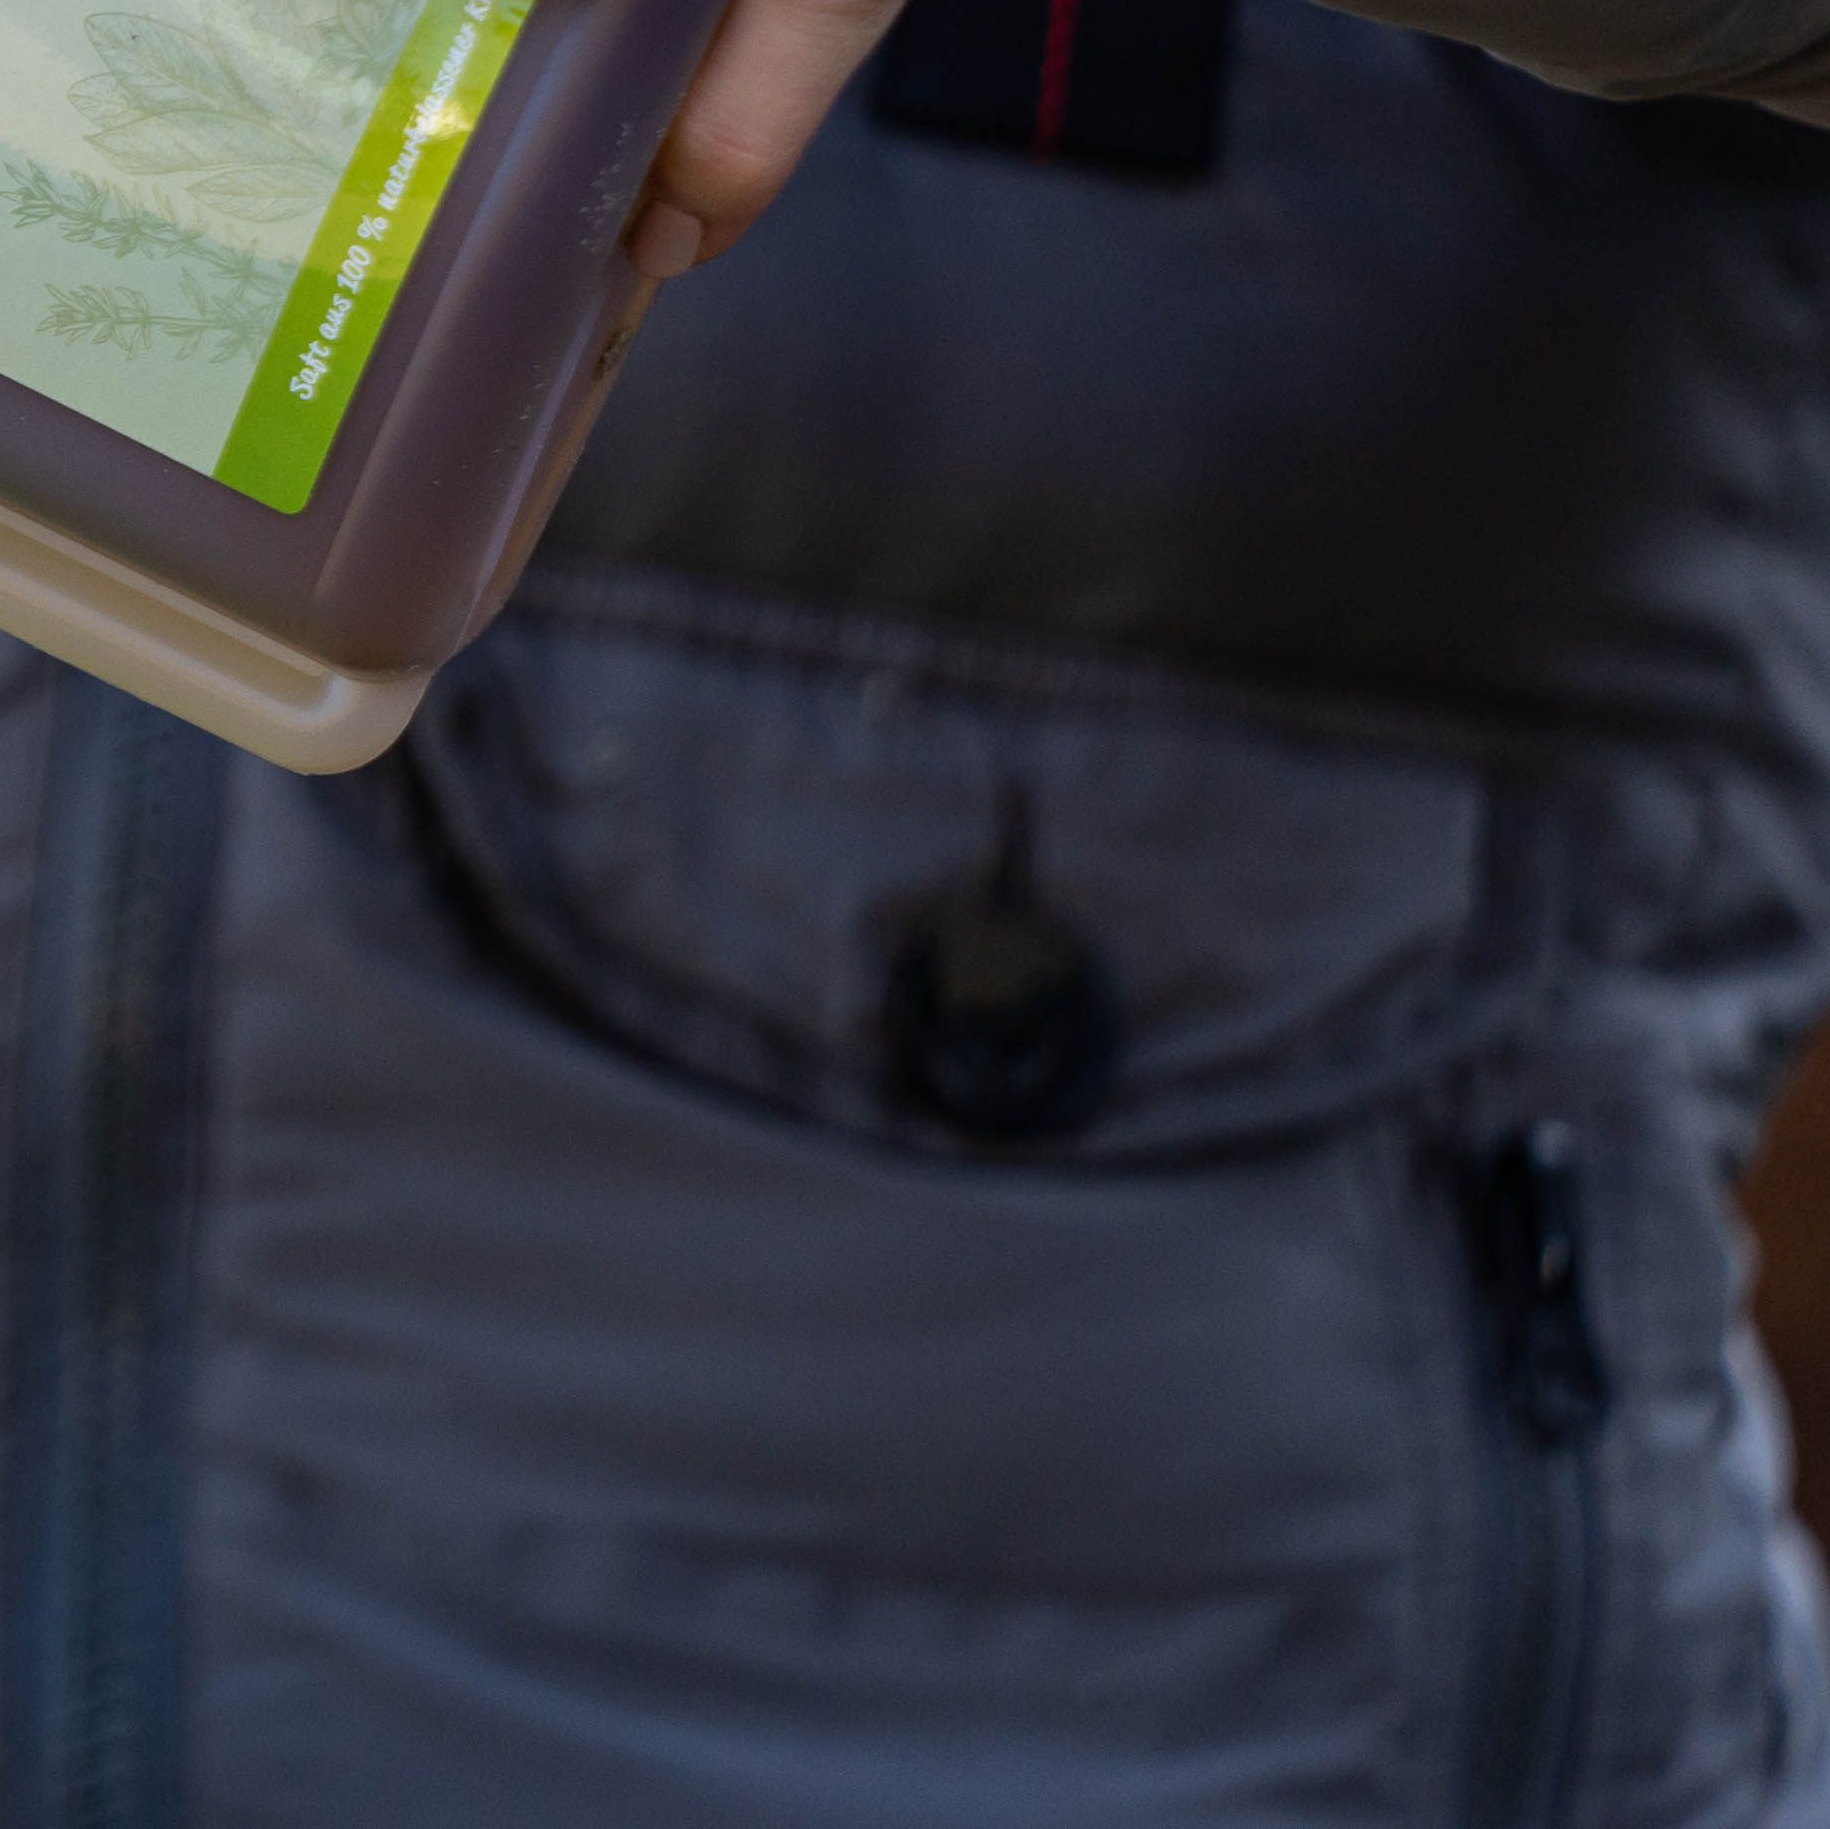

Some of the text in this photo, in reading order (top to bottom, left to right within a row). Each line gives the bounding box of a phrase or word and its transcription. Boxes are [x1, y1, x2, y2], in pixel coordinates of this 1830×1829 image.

[289, 341, 331, 400] Saft
[319, 294, 352, 340] aus
[337, 245, 372, 293] 100
[357, 215, 389, 241] %
